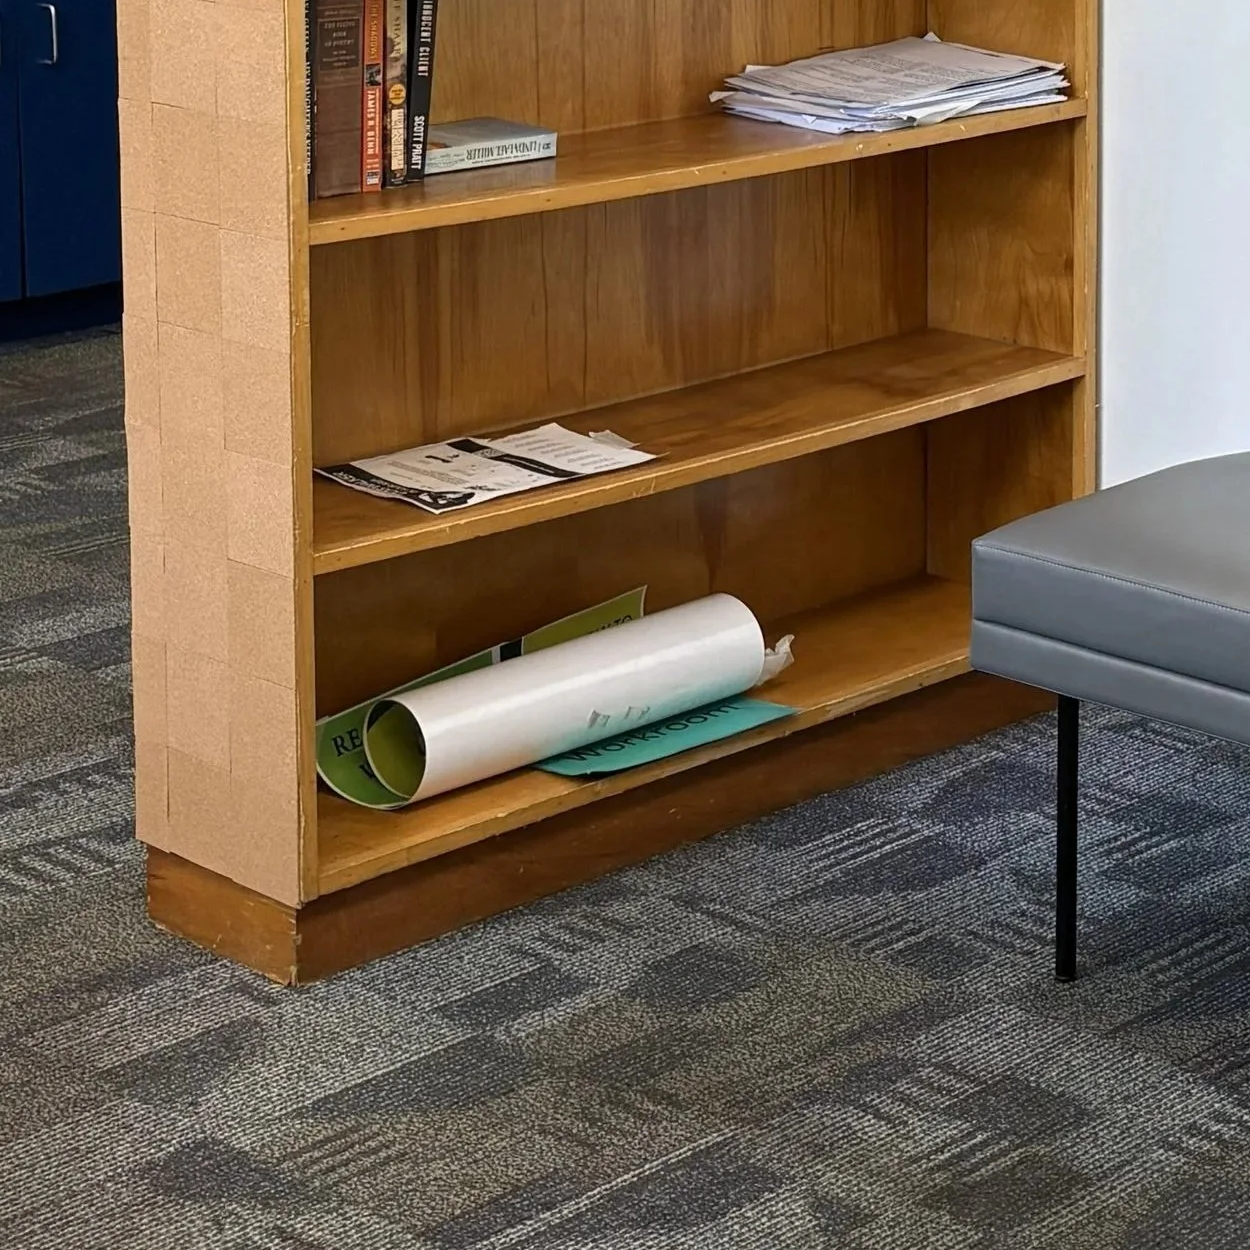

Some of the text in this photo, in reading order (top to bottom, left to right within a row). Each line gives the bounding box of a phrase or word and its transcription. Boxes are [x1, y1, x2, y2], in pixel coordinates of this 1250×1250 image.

[420, 0, 434, 43] INNOCENT
[417, 46, 431, 77] CLIENT
[366, 90, 376, 119] JAMES
[410, 115, 426, 170] SCOTT PRATT
[466, 145, 494, 161] MILLER
[560, 701, 743, 762] Workroom
